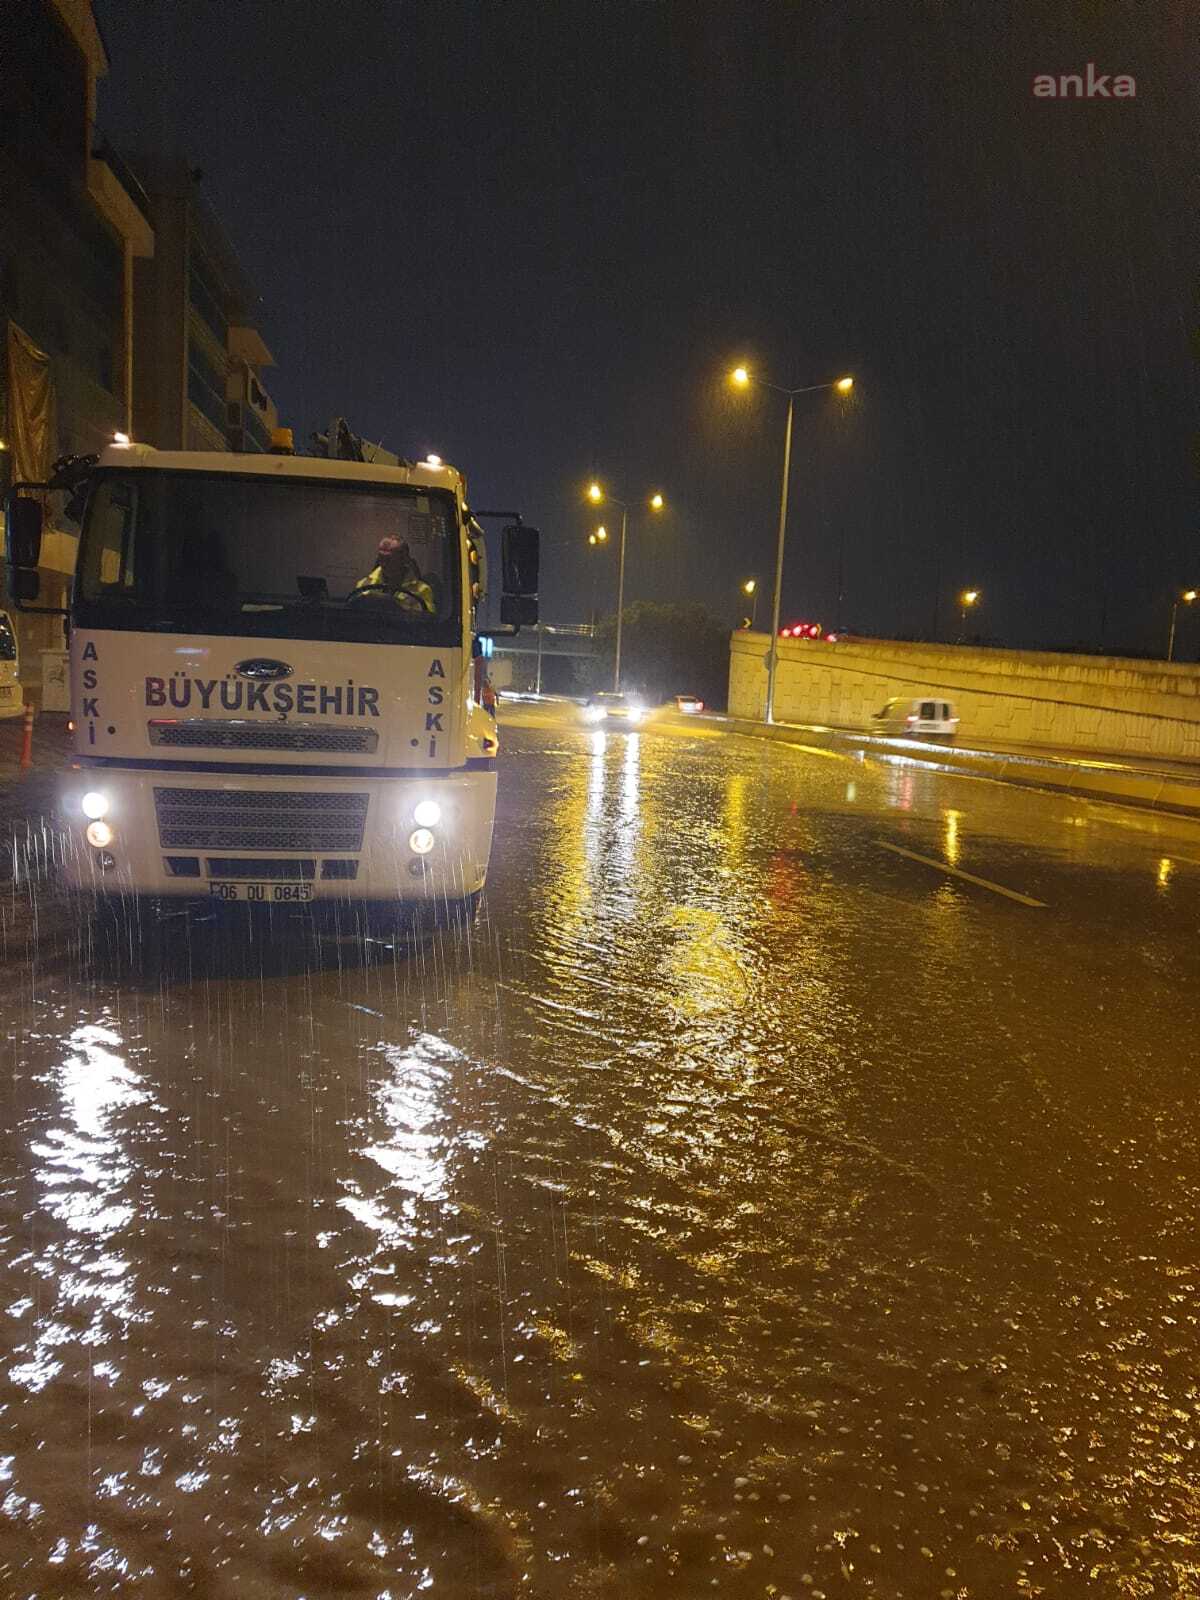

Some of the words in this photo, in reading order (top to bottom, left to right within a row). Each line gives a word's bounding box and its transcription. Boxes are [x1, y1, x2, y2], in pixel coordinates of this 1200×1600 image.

[82, 641, 99, 745] ASKİ
[145, 672, 380, 721] BÜYÜKŞEHİR
[425, 659, 445, 758] ASKİ
[220, 884, 238, 899] 06
